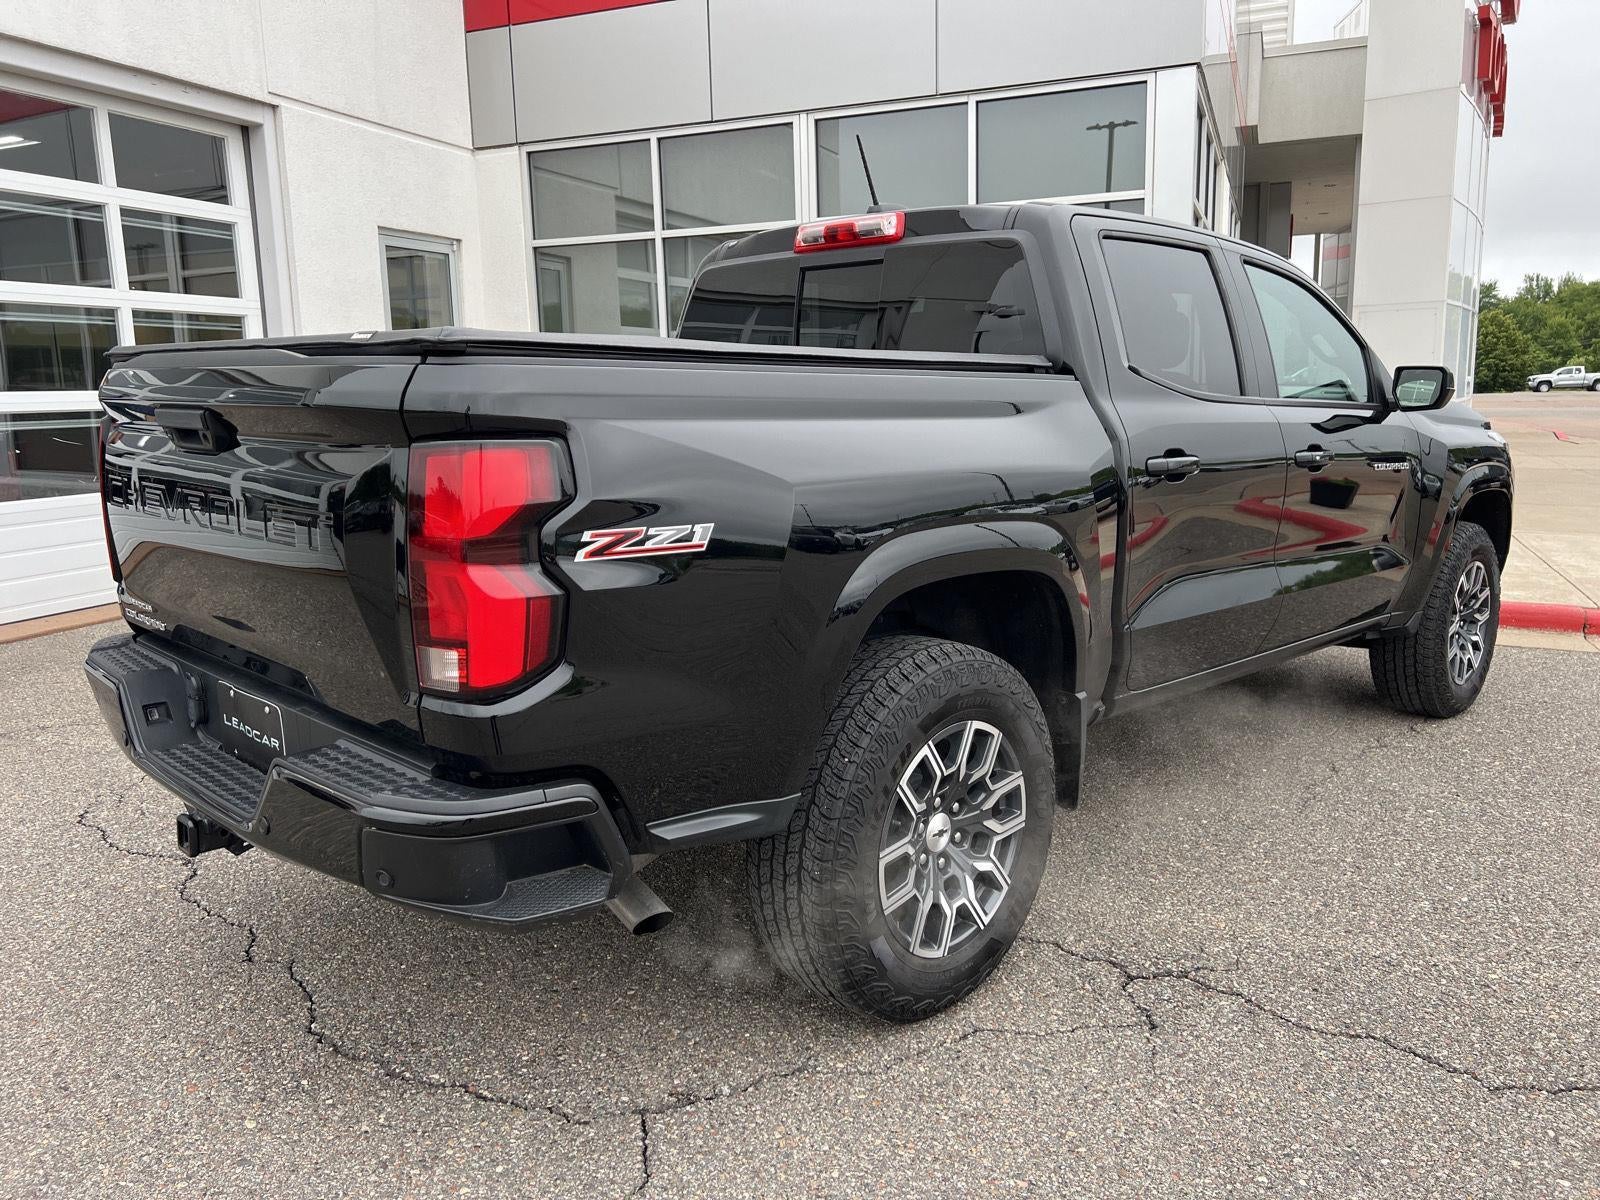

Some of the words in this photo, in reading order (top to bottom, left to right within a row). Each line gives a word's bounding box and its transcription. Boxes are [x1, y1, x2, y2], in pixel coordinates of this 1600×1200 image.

[107, 474, 334, 551] CHEVROLET
[574, 523, 715, 562] Z71
[223, 713, 280, 751] LEADCAR
